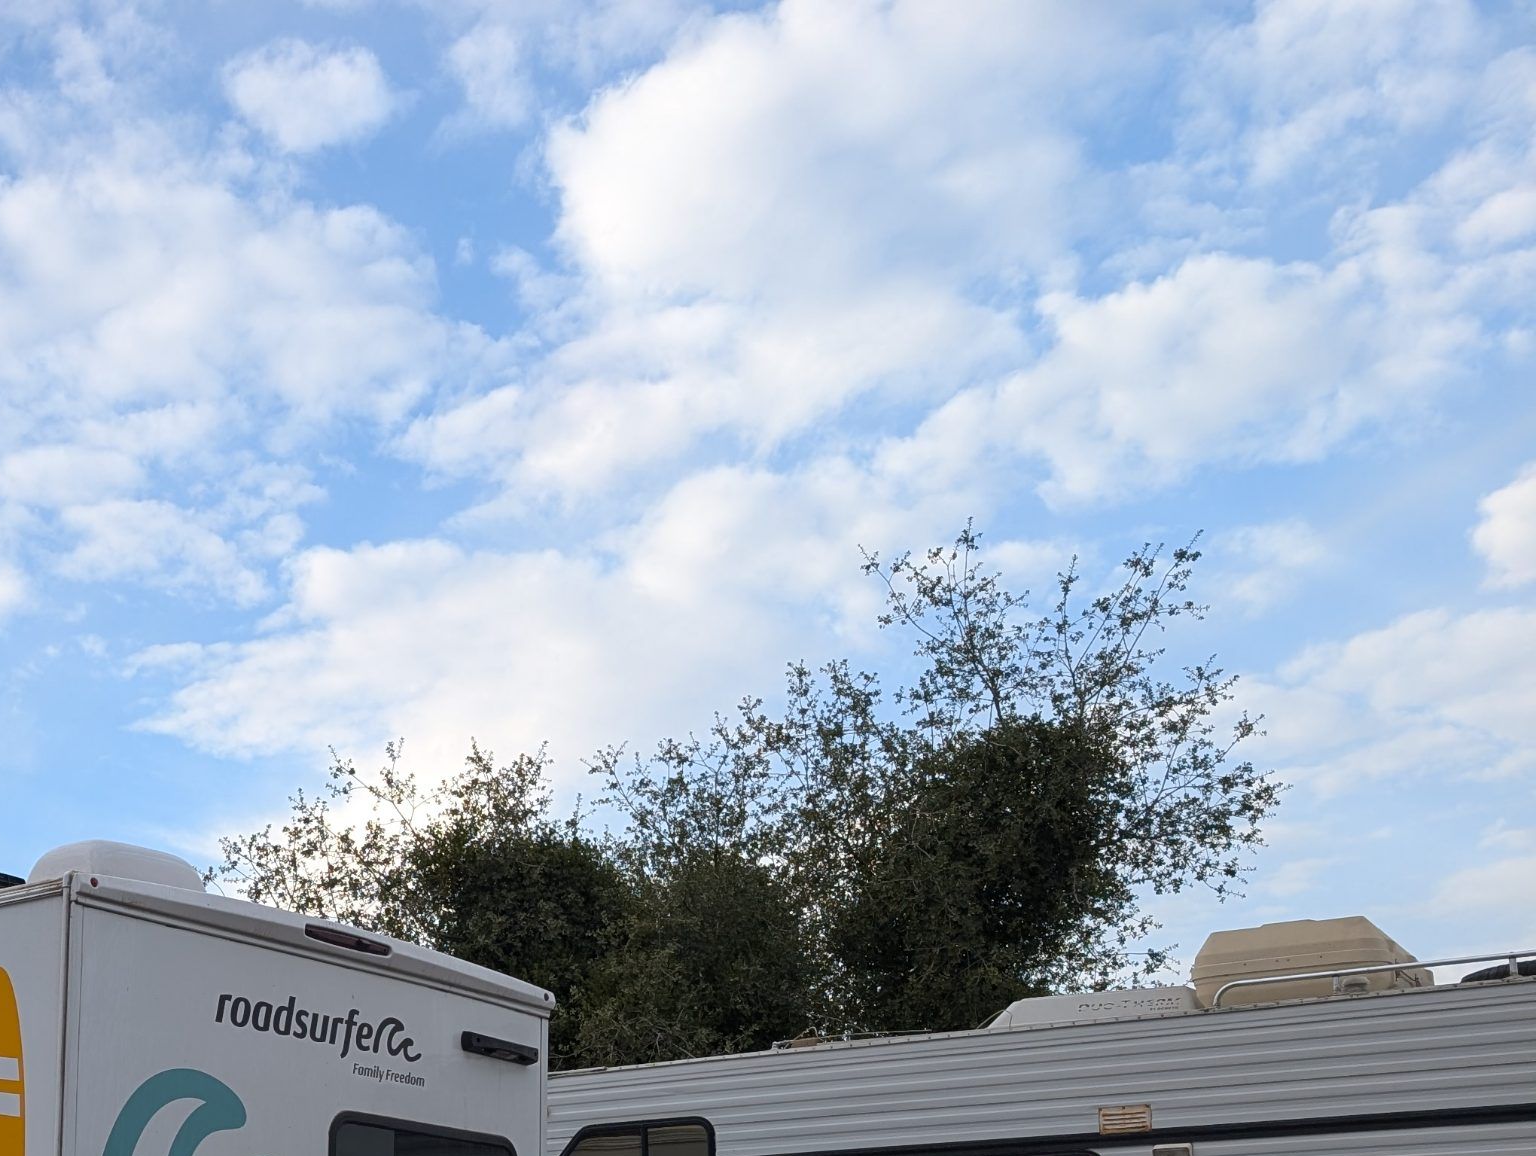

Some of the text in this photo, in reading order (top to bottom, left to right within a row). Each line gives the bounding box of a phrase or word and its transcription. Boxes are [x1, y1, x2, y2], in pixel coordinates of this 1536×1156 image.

[215, 994, 422, 1063] roadsurfer
[352, 1062, 425, 1088] Family Freedom
